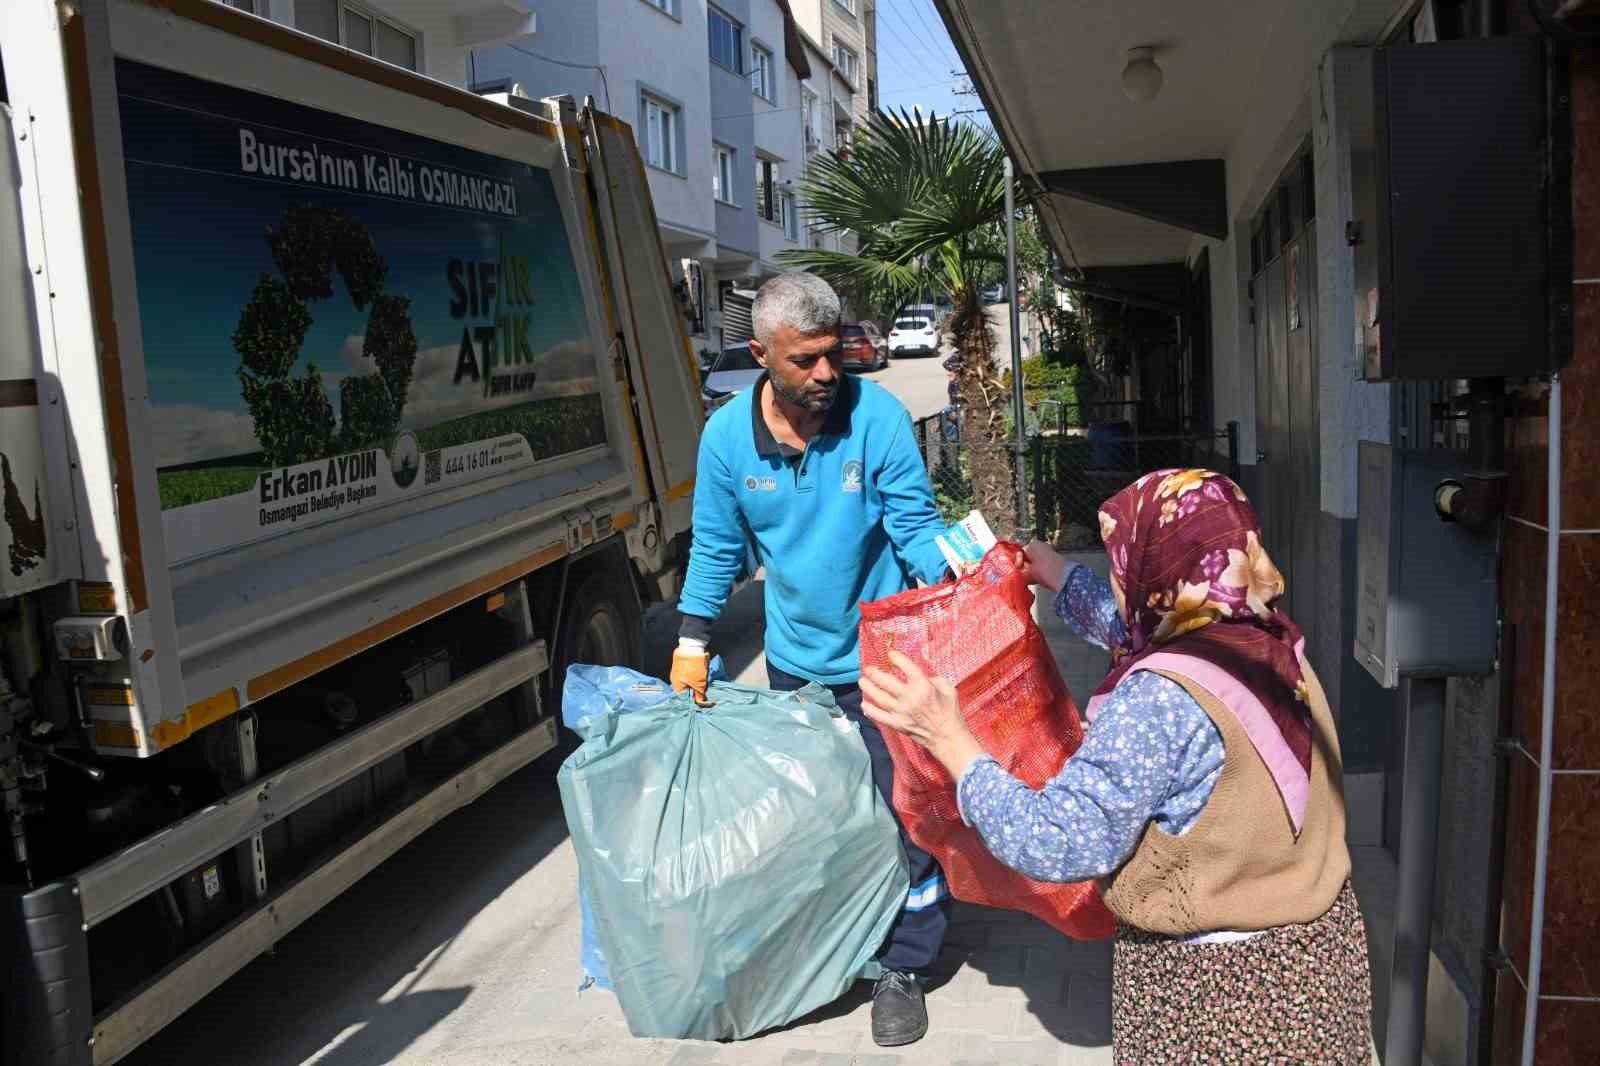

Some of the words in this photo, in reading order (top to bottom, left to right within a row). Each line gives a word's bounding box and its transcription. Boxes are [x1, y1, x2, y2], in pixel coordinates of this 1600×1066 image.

[239, 128, 358, 189] Bursa'nın
[363, 154, 415, 198] Kalbi
[420, 165, 518, 217] OSMANGAZİ
[260, 469, 321, 503] Erkan
[326, 450, 377, 488] AYDIN
[446, 455, 464, 475] 444
[467, 453, 477, 472] 16
[480, 450, 489, 468] 01
[259, 497, 309, 525] Osmangazi
[311, 490, 345, 512] Belediye
